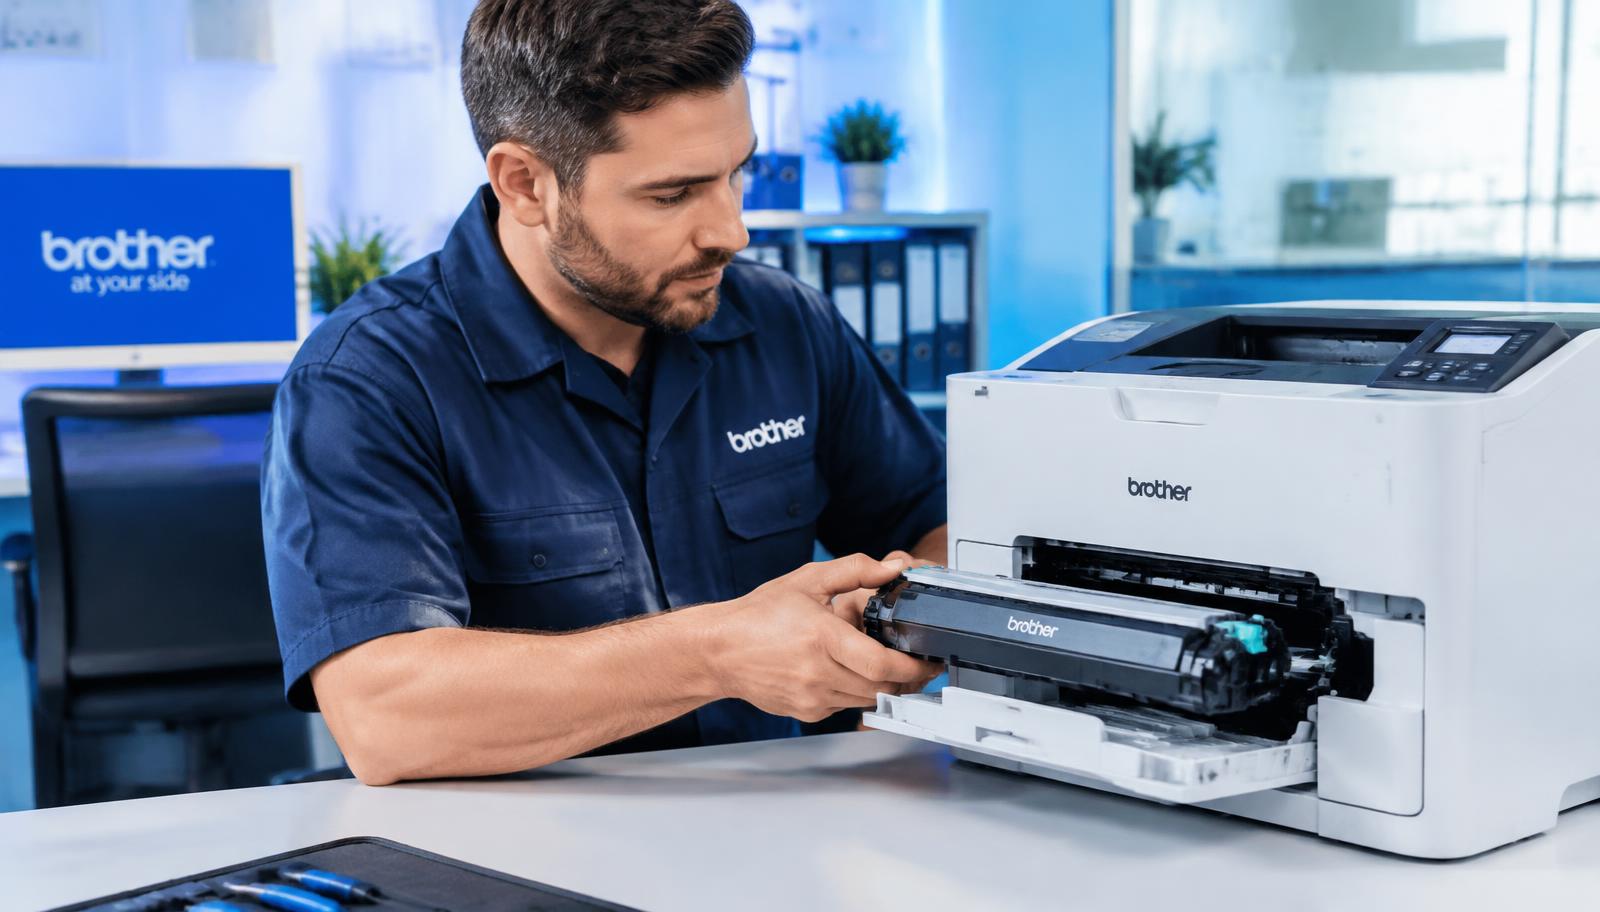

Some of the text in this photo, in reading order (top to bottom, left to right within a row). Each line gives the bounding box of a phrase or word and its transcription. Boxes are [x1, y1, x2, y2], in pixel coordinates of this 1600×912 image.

[41, 229, 214, 271] brother
[71, 271, 190, 297] at your side
[727, 415, 806, 453] brother
[1128, 476, 1192, 502] brother
[1007, 616, 1059, 638] brother
